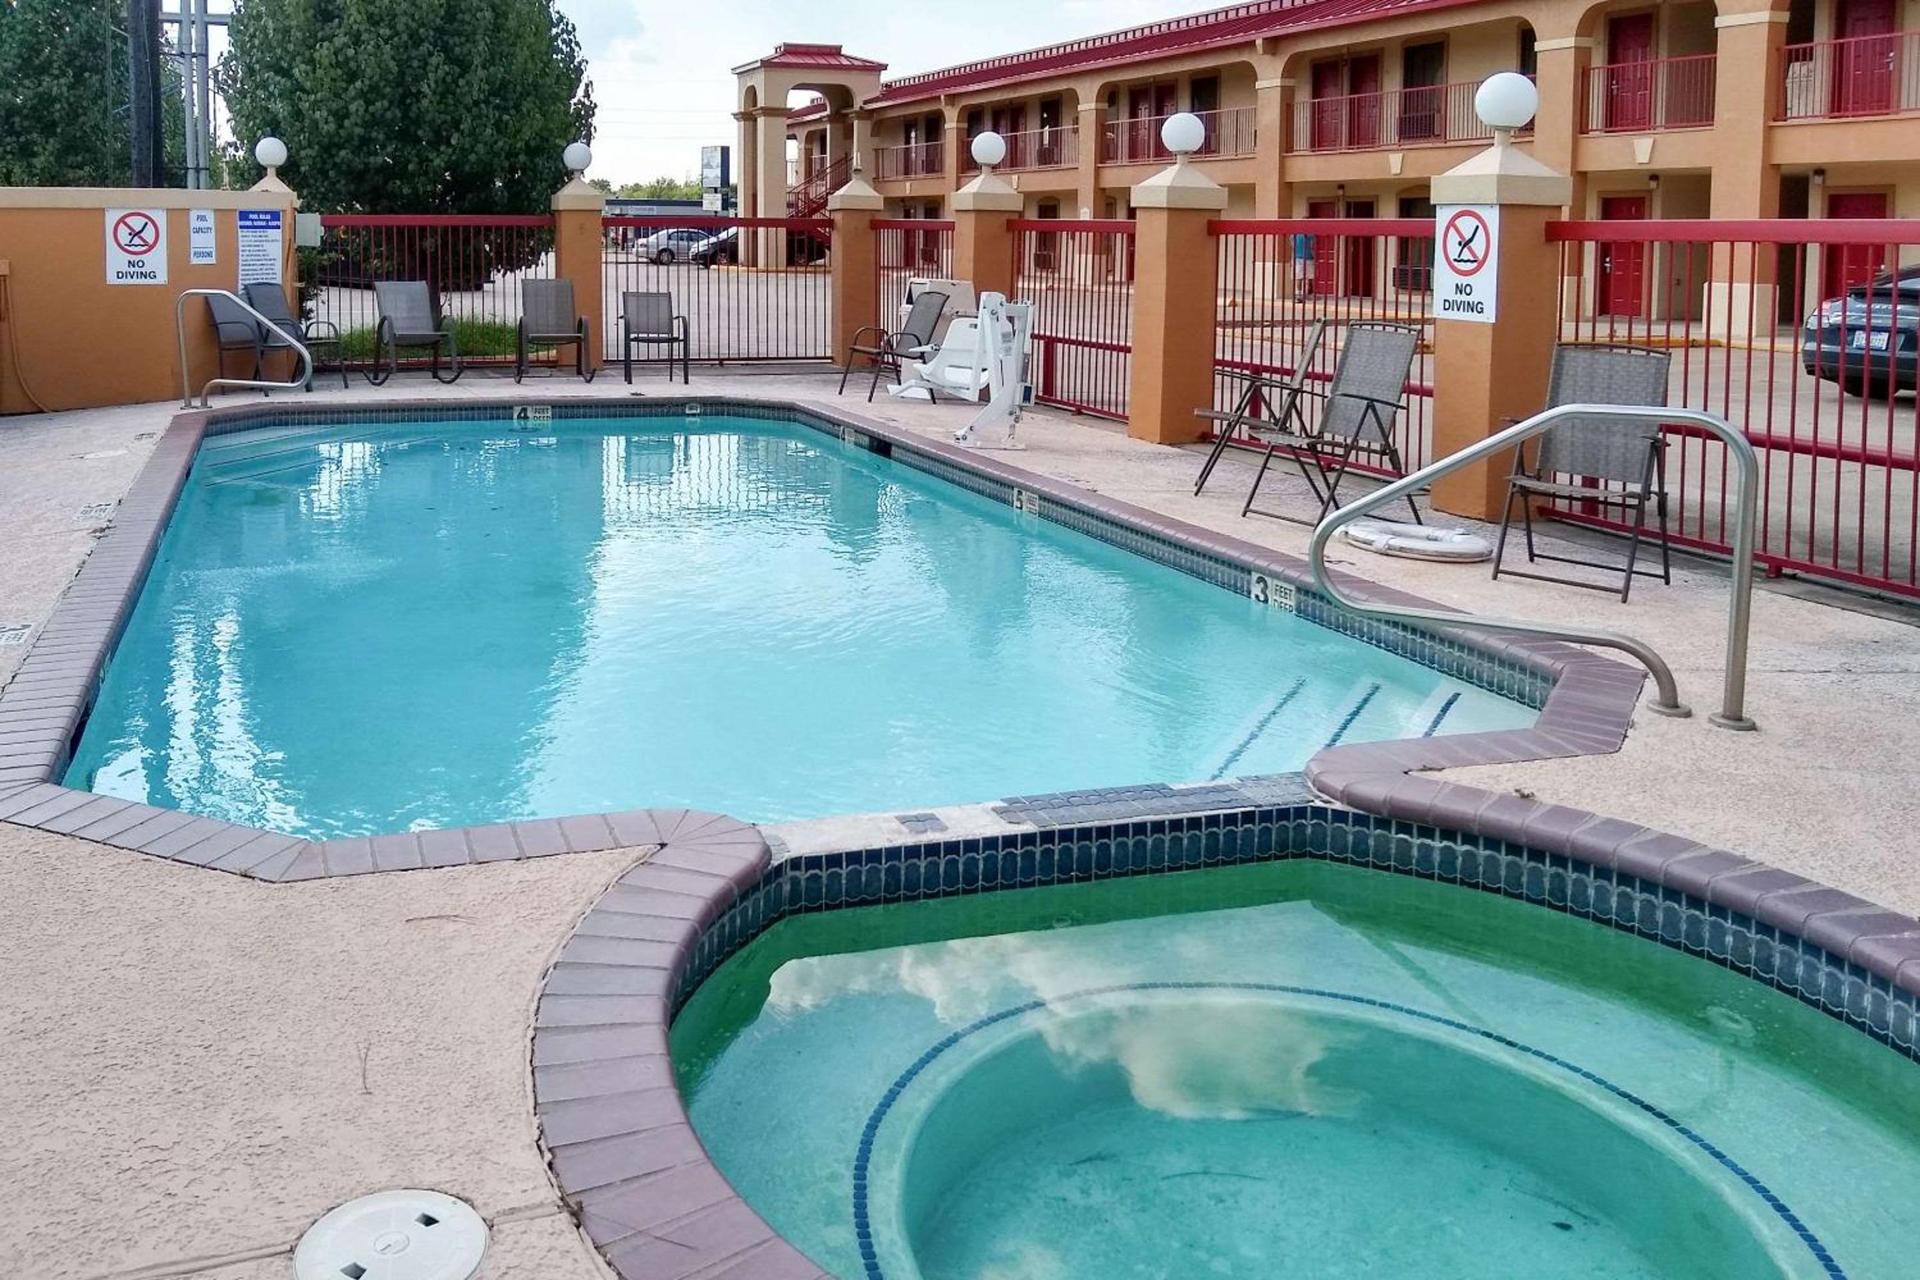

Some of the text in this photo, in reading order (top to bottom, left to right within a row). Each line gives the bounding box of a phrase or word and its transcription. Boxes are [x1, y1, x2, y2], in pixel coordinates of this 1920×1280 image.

[127, 259, 146, 269] NO
[116, 271, 157, 280] DIVING
[1455, 283, 1473, 296] NO
[1443, 299, 1484, 314] DIVING
[517, 407, 530, 420] 4
[1255, 576, 1293, 604] 3 FEET
